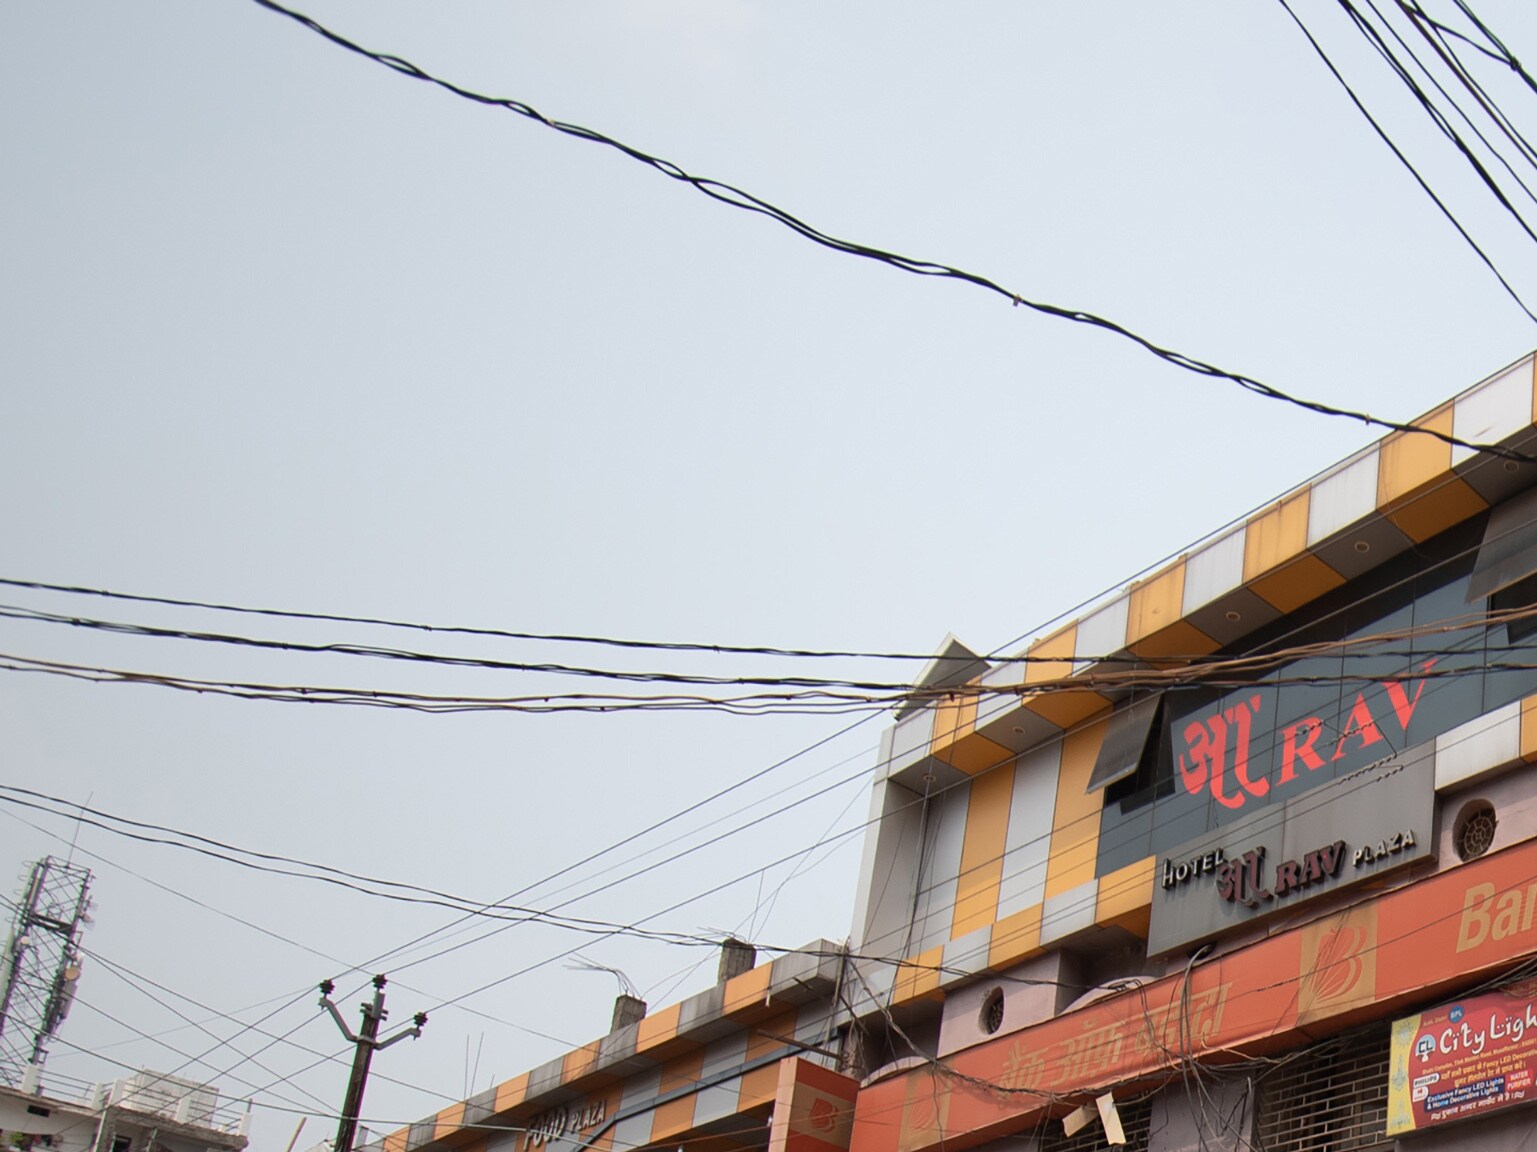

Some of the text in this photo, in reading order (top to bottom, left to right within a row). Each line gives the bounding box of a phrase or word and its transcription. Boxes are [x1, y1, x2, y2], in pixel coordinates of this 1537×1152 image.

[1275, 658, 1439, 787] RAV
[1162, 848, 1224, 889] HOTEL
[1275, 840, 1347, 895] RAV
[1352, 829, 1416, 867] PLAZA
[1440, 1022, 1485, 1055] City
[1482, 1059, 1499, 1070] Fancy
[1500, 1055, 1512, 1063] LED
[1507, 1078, 1532, 1090] PURIFIER
[1510, 1070, 1529, 1081] WATER
[1454, 1086, 1472, 1098] Fancy
[1472, 1082, 1485, 1092] LED
[1486, 1078, 1504, 1090] Lights
[1481, 1086, 1499, 1098] Lights
[570, 1099, 607, 1134] PLAZA
